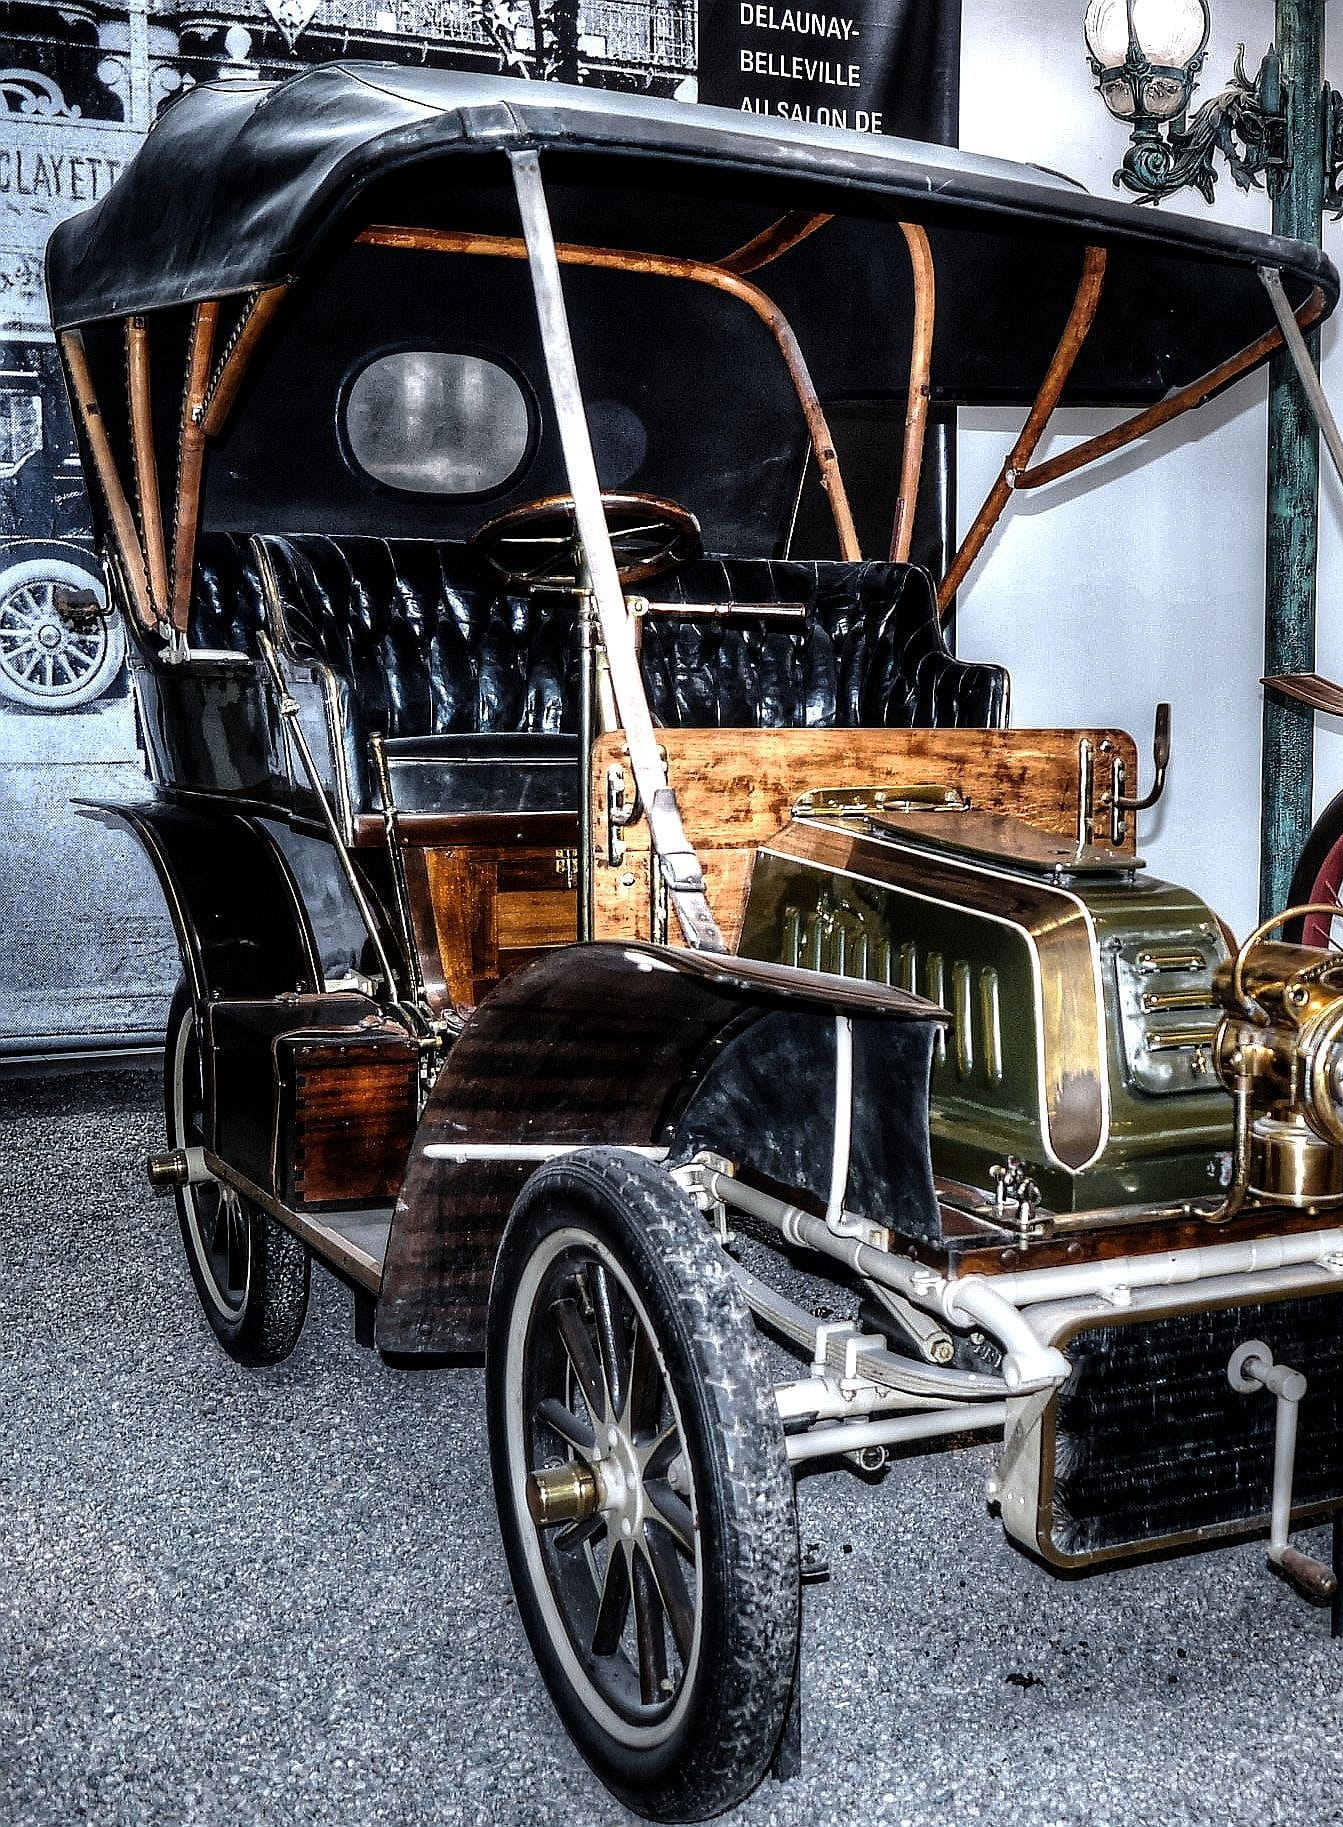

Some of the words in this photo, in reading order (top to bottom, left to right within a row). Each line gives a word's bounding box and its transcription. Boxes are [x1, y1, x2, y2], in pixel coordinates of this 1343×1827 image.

[740, 2, 860, 41] DELAUNAY-
[740, 49, 861, 87] BELLEVILLE
[740, 96, 769, 116] AU
[777, 101, 848, 130] SALON
[855, 110, 883, 134] DE
